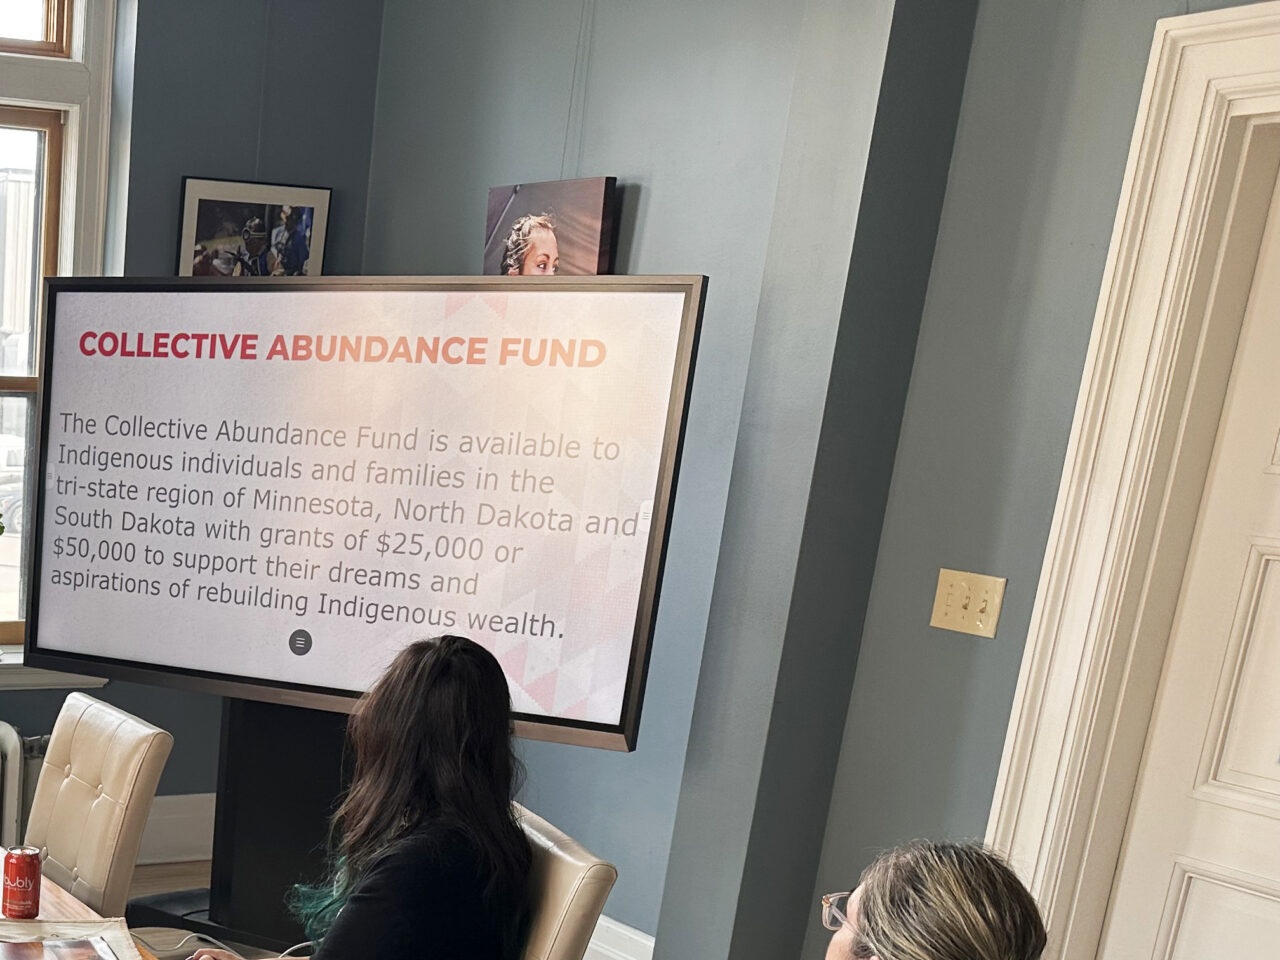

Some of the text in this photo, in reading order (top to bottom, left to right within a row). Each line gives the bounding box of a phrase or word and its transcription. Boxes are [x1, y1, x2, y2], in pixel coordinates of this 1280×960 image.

[79, 331, 607, 367] COLLECTIVE ABUNDANCE FUND
[60, 413, 620, 460] The Collective Abundance Fund is available to
[58, 444, 554, 493] Indigenous individuals and families in the
[56, 476, 639, 537] tri-state region of Minnesota, North Dakota and
[54, 506, 523, 564] South Dakota with grants of $25,000 or
[53, 536, 478, 596] $50,000 to support their dreams and
[51, 567, 564, 639] aspirations of rebuilding Indigenous wealth.
[4, 873, 35, 891] bubly
